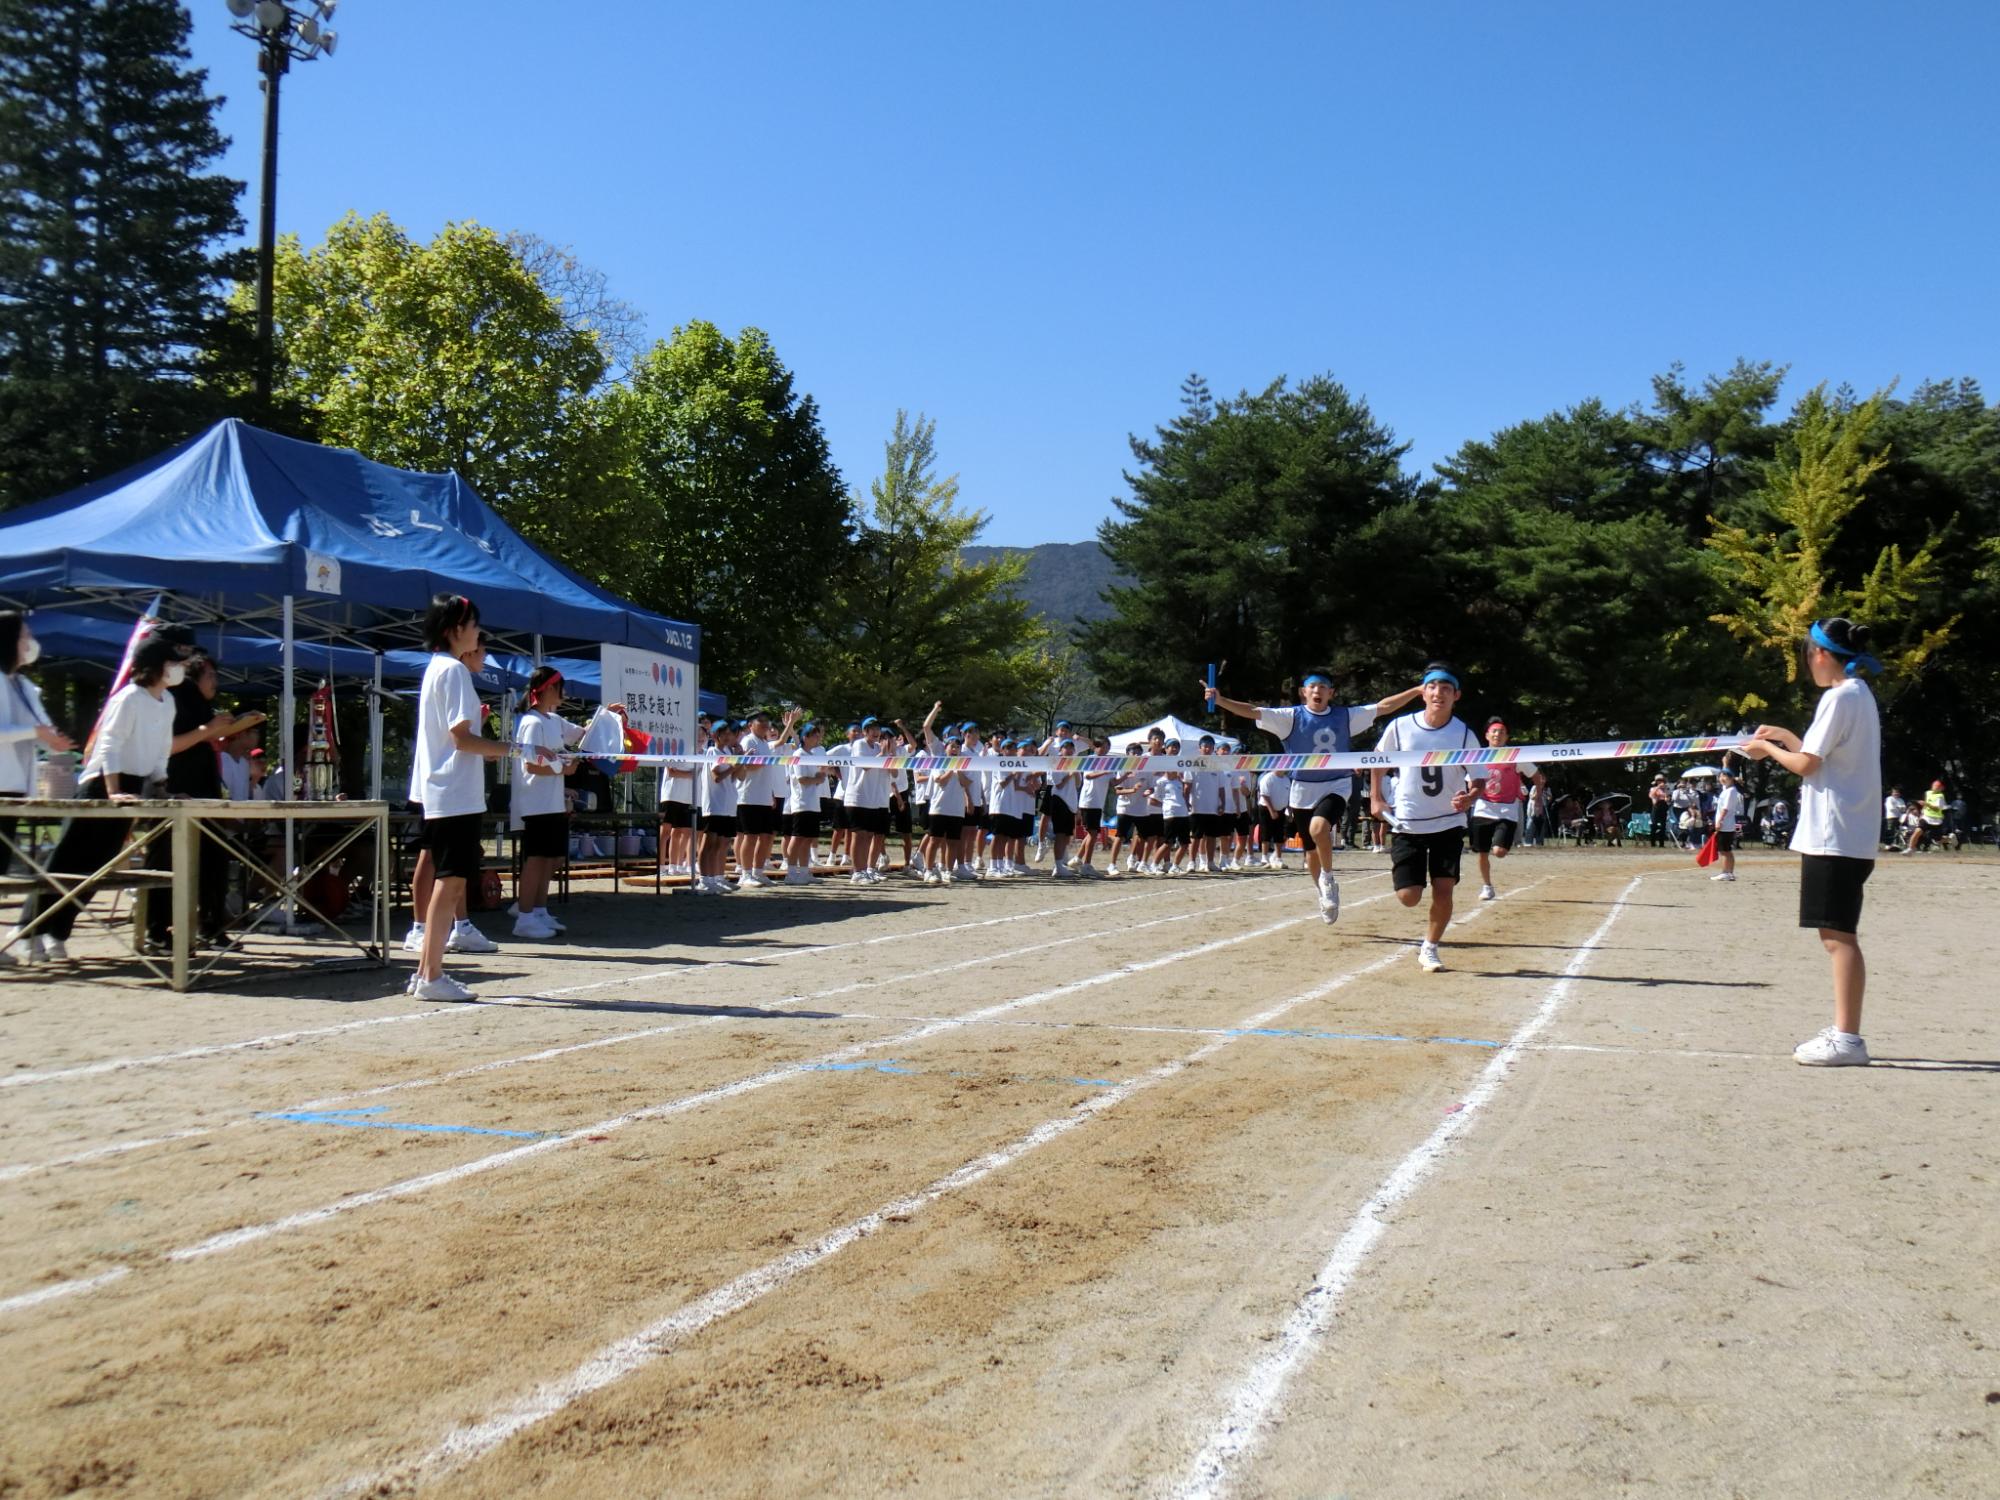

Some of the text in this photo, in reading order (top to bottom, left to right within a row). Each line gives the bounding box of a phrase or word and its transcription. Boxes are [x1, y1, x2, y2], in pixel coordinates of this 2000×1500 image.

[626, 693, 680, 717] 限界を超えて
[1552, 748, 1583, 757] GOAL
[1000, 760, 1028, 768] GOAL
[1177, 759, 1206, 768] GOAL
[1361, 756, 1391, 764] GOAL
[1421, 766, 1443, 797] 9
